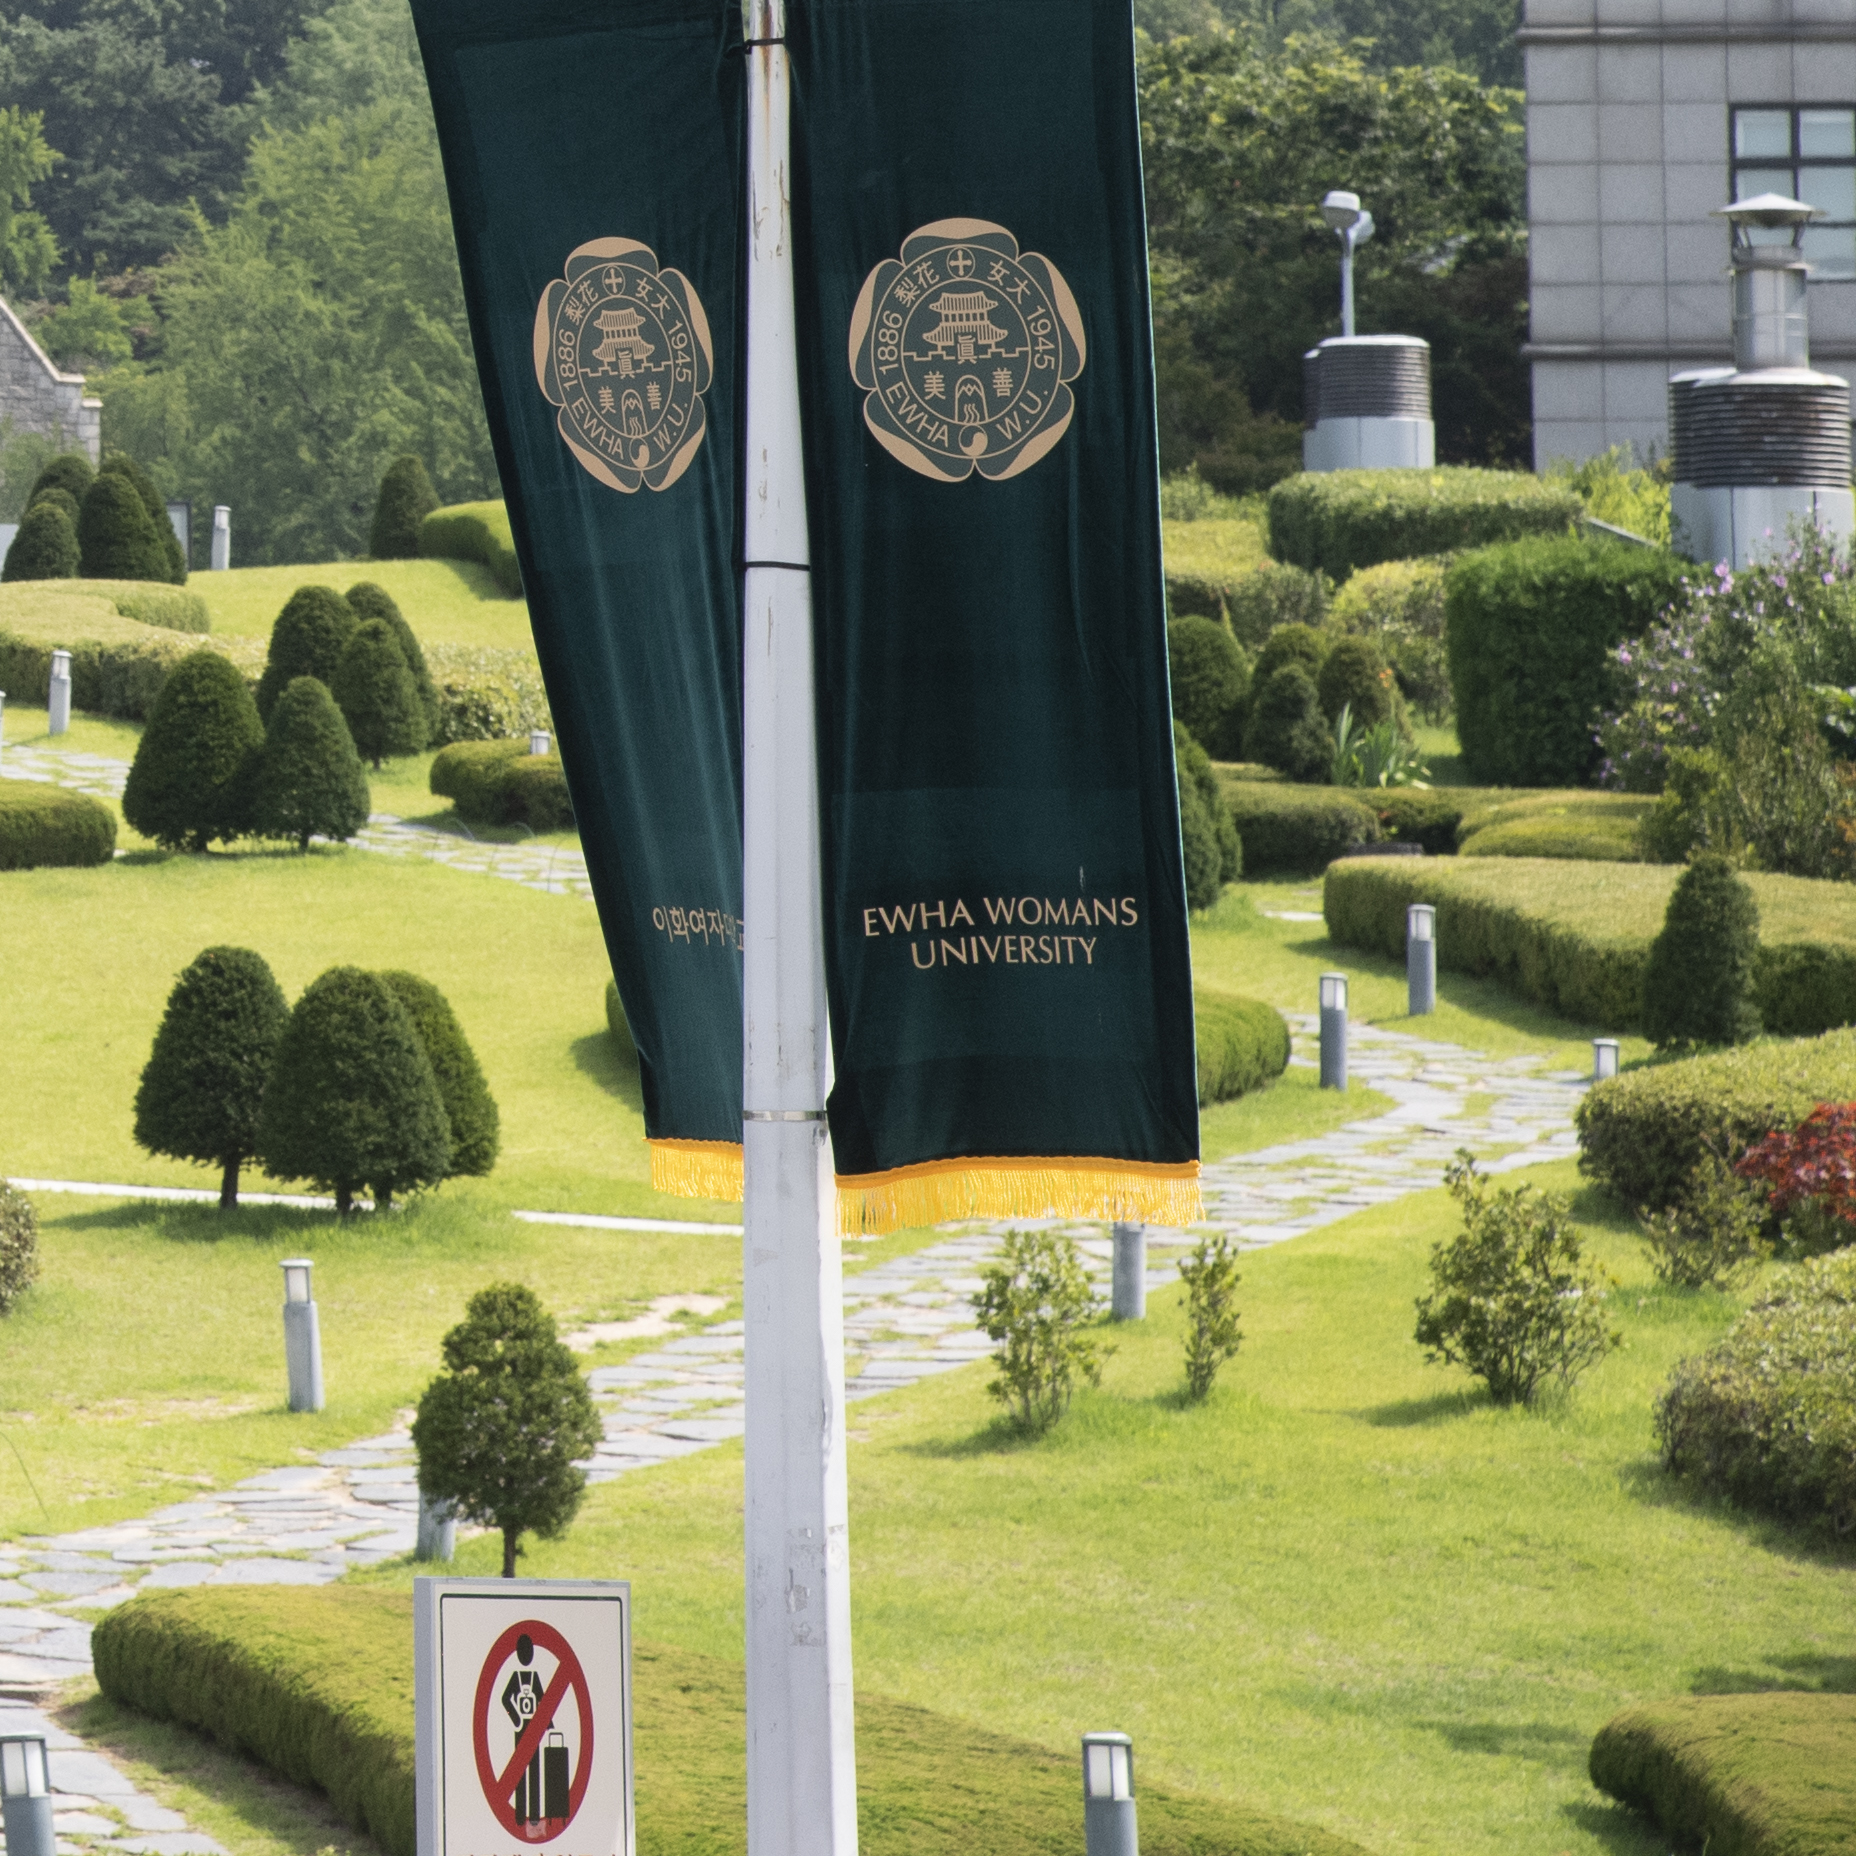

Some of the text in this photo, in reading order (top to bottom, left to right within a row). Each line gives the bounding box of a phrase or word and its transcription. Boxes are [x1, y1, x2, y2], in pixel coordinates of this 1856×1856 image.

[558, 328, 578, 391] 1886
[668, 320, 692, 382] 1945
[877, 310, 903, 375] 1886
[1026, 306, 1056, 371] 1945
[571, 397, 625, 460] EWHA
[885, 381, 949, 448] EWHA
[863, 897, 1138, 937] EWHA WOMANS
[911, 935, 1097, 969] UNIVERSITY
